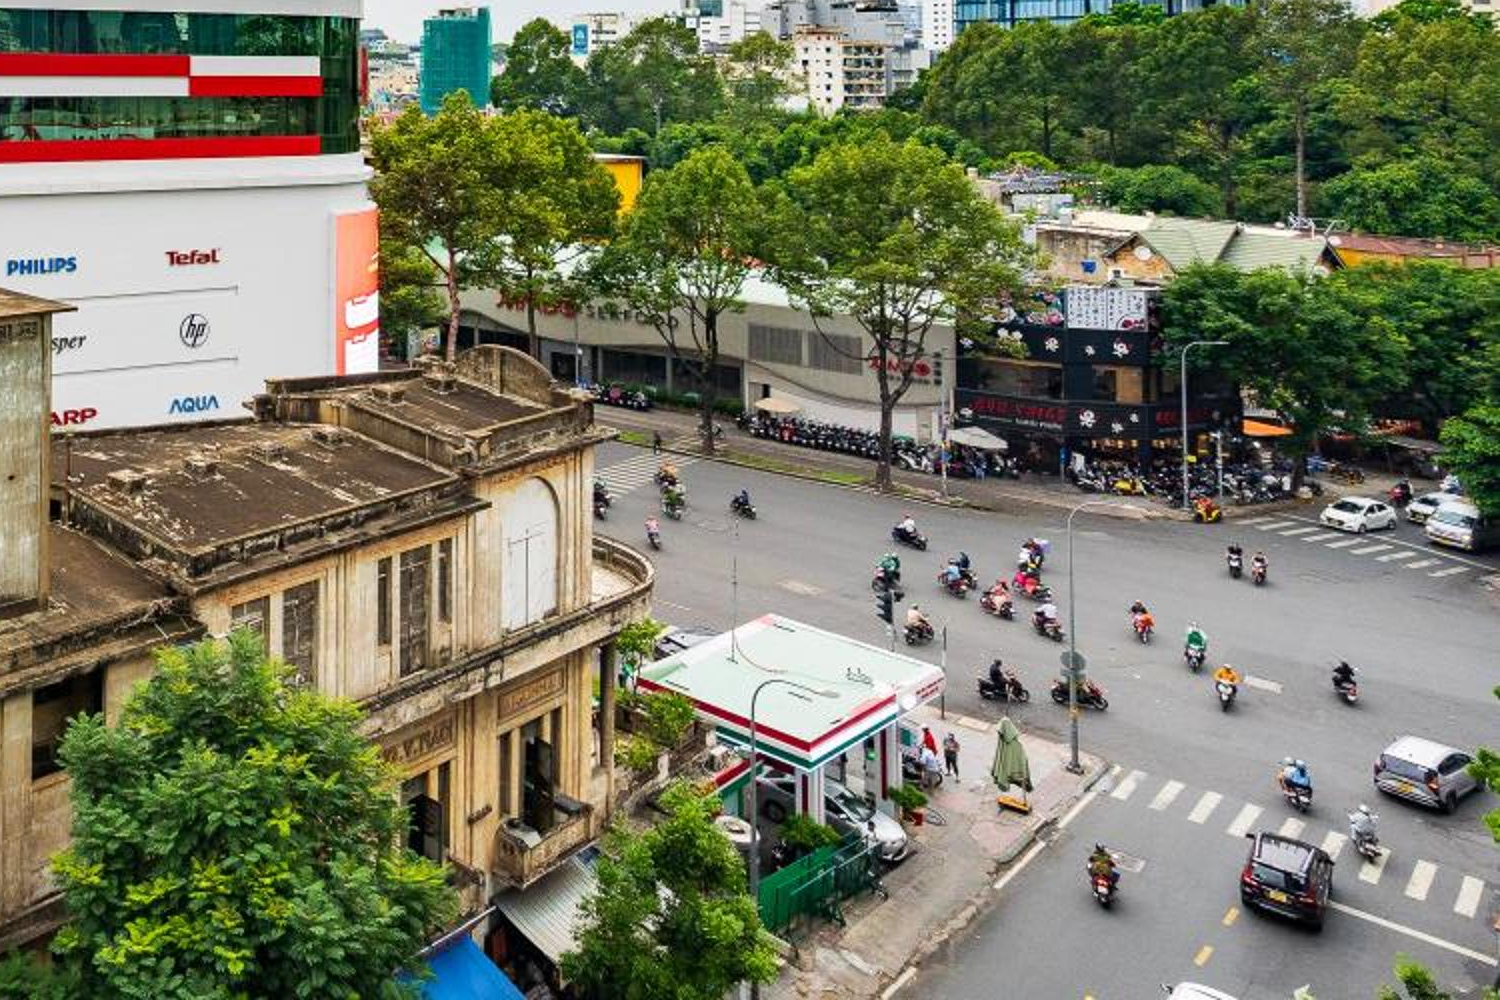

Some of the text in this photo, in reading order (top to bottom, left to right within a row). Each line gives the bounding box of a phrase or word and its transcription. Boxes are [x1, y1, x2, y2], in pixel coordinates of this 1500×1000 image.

[6, 256, 77, 276] PHILIPS
[165, 248, 220, 266] Tefal
[181, 313, 209, 348] hp
[169, 395, 219, 414] AQUA
[51, 408, 98, 426] ARP
